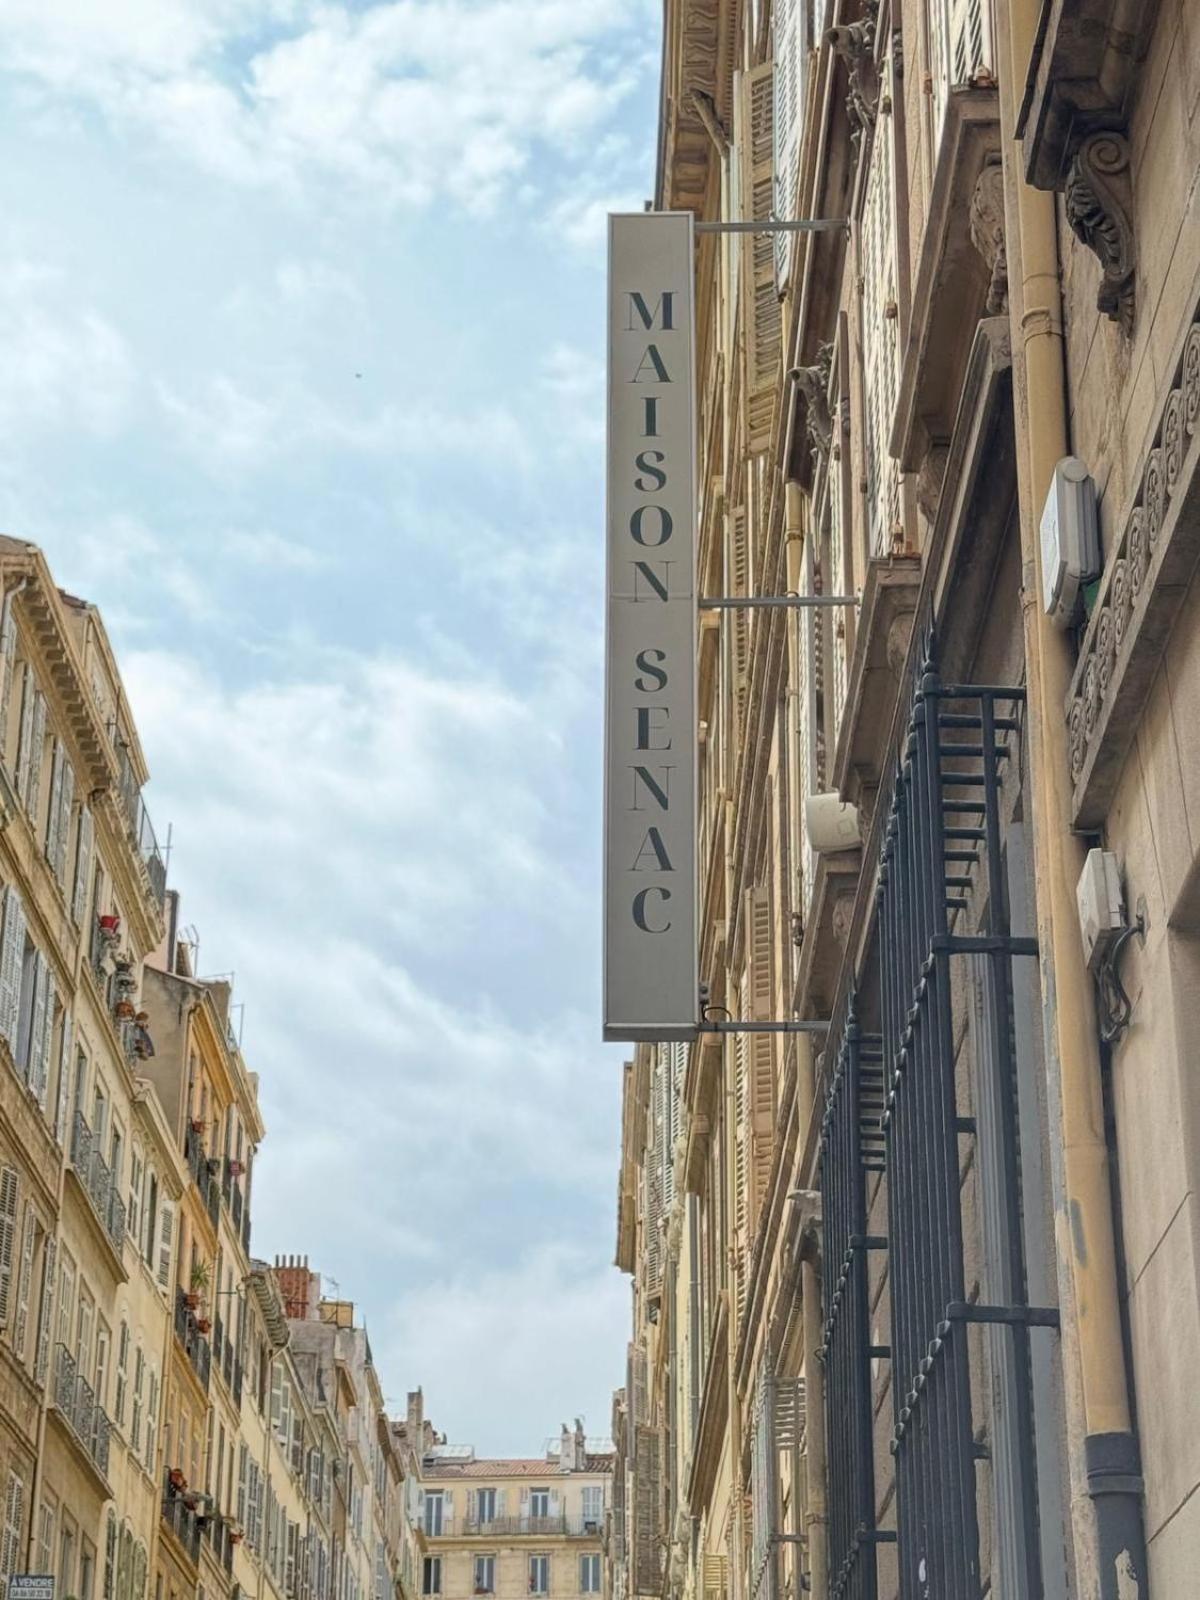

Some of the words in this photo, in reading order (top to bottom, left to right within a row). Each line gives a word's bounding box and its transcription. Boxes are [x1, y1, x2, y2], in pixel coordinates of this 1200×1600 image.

[624, 291, 677, 603] MAISON
[626, 648, 677, 933] SENAC
[18, 1578, 53, 1587] VENDRE
